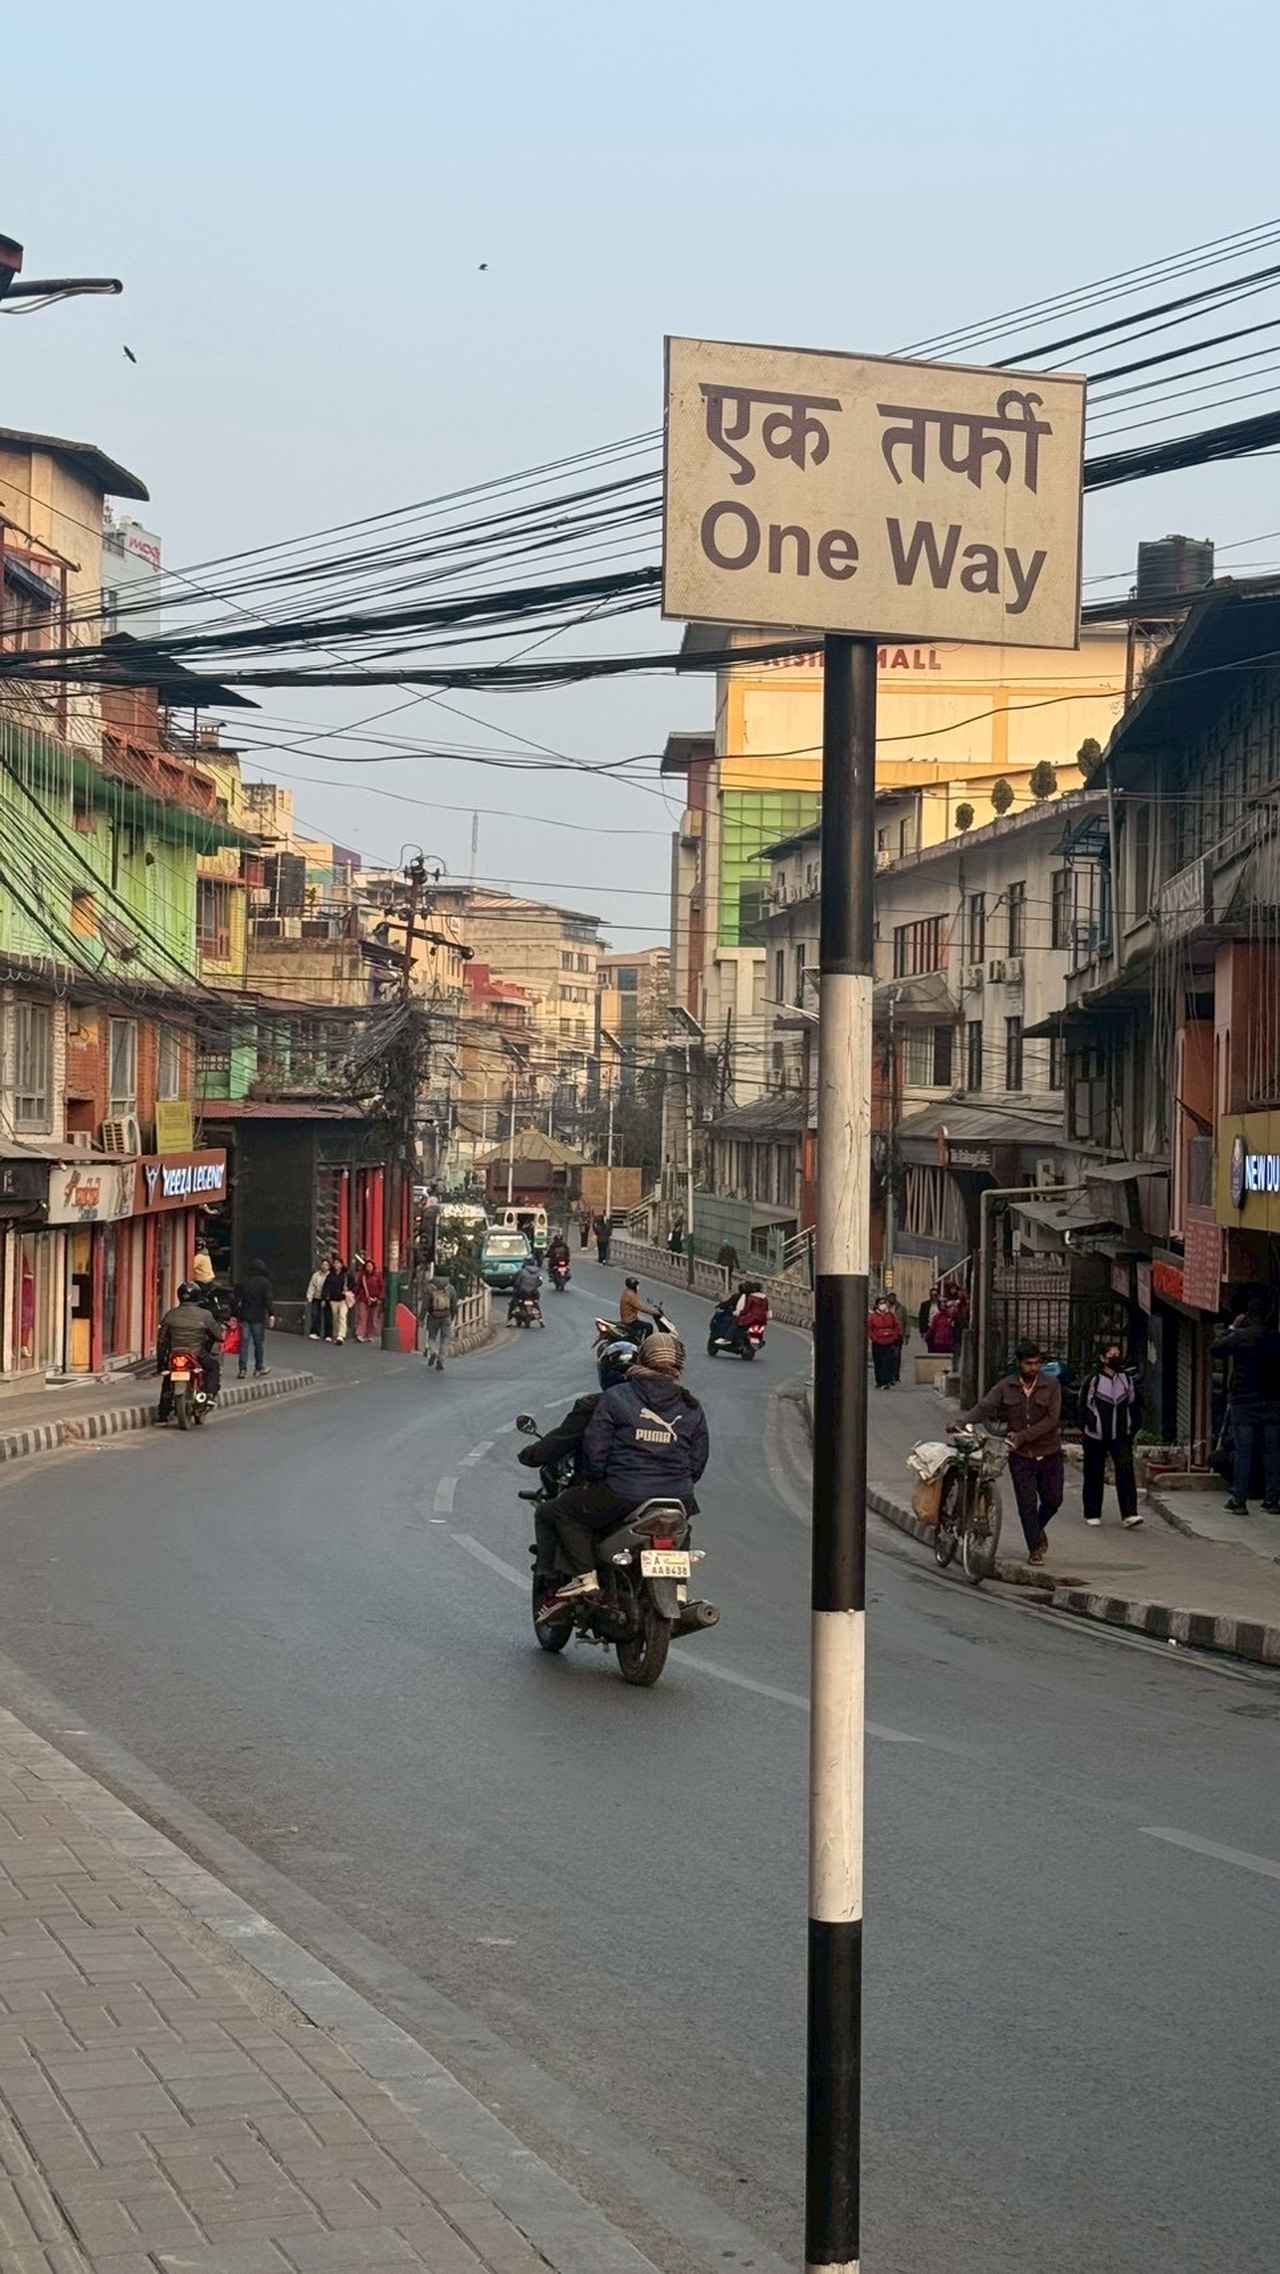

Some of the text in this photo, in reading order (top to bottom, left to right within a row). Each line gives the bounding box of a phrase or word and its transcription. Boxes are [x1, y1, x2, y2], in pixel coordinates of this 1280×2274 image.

[698, 382, 1053, 495] एक तर्फी
[700, 500, 1048, 615] One Way
[1245, 1155, 1265, 1191] NEW
[635, 1428, 671, 1443] PUMA
